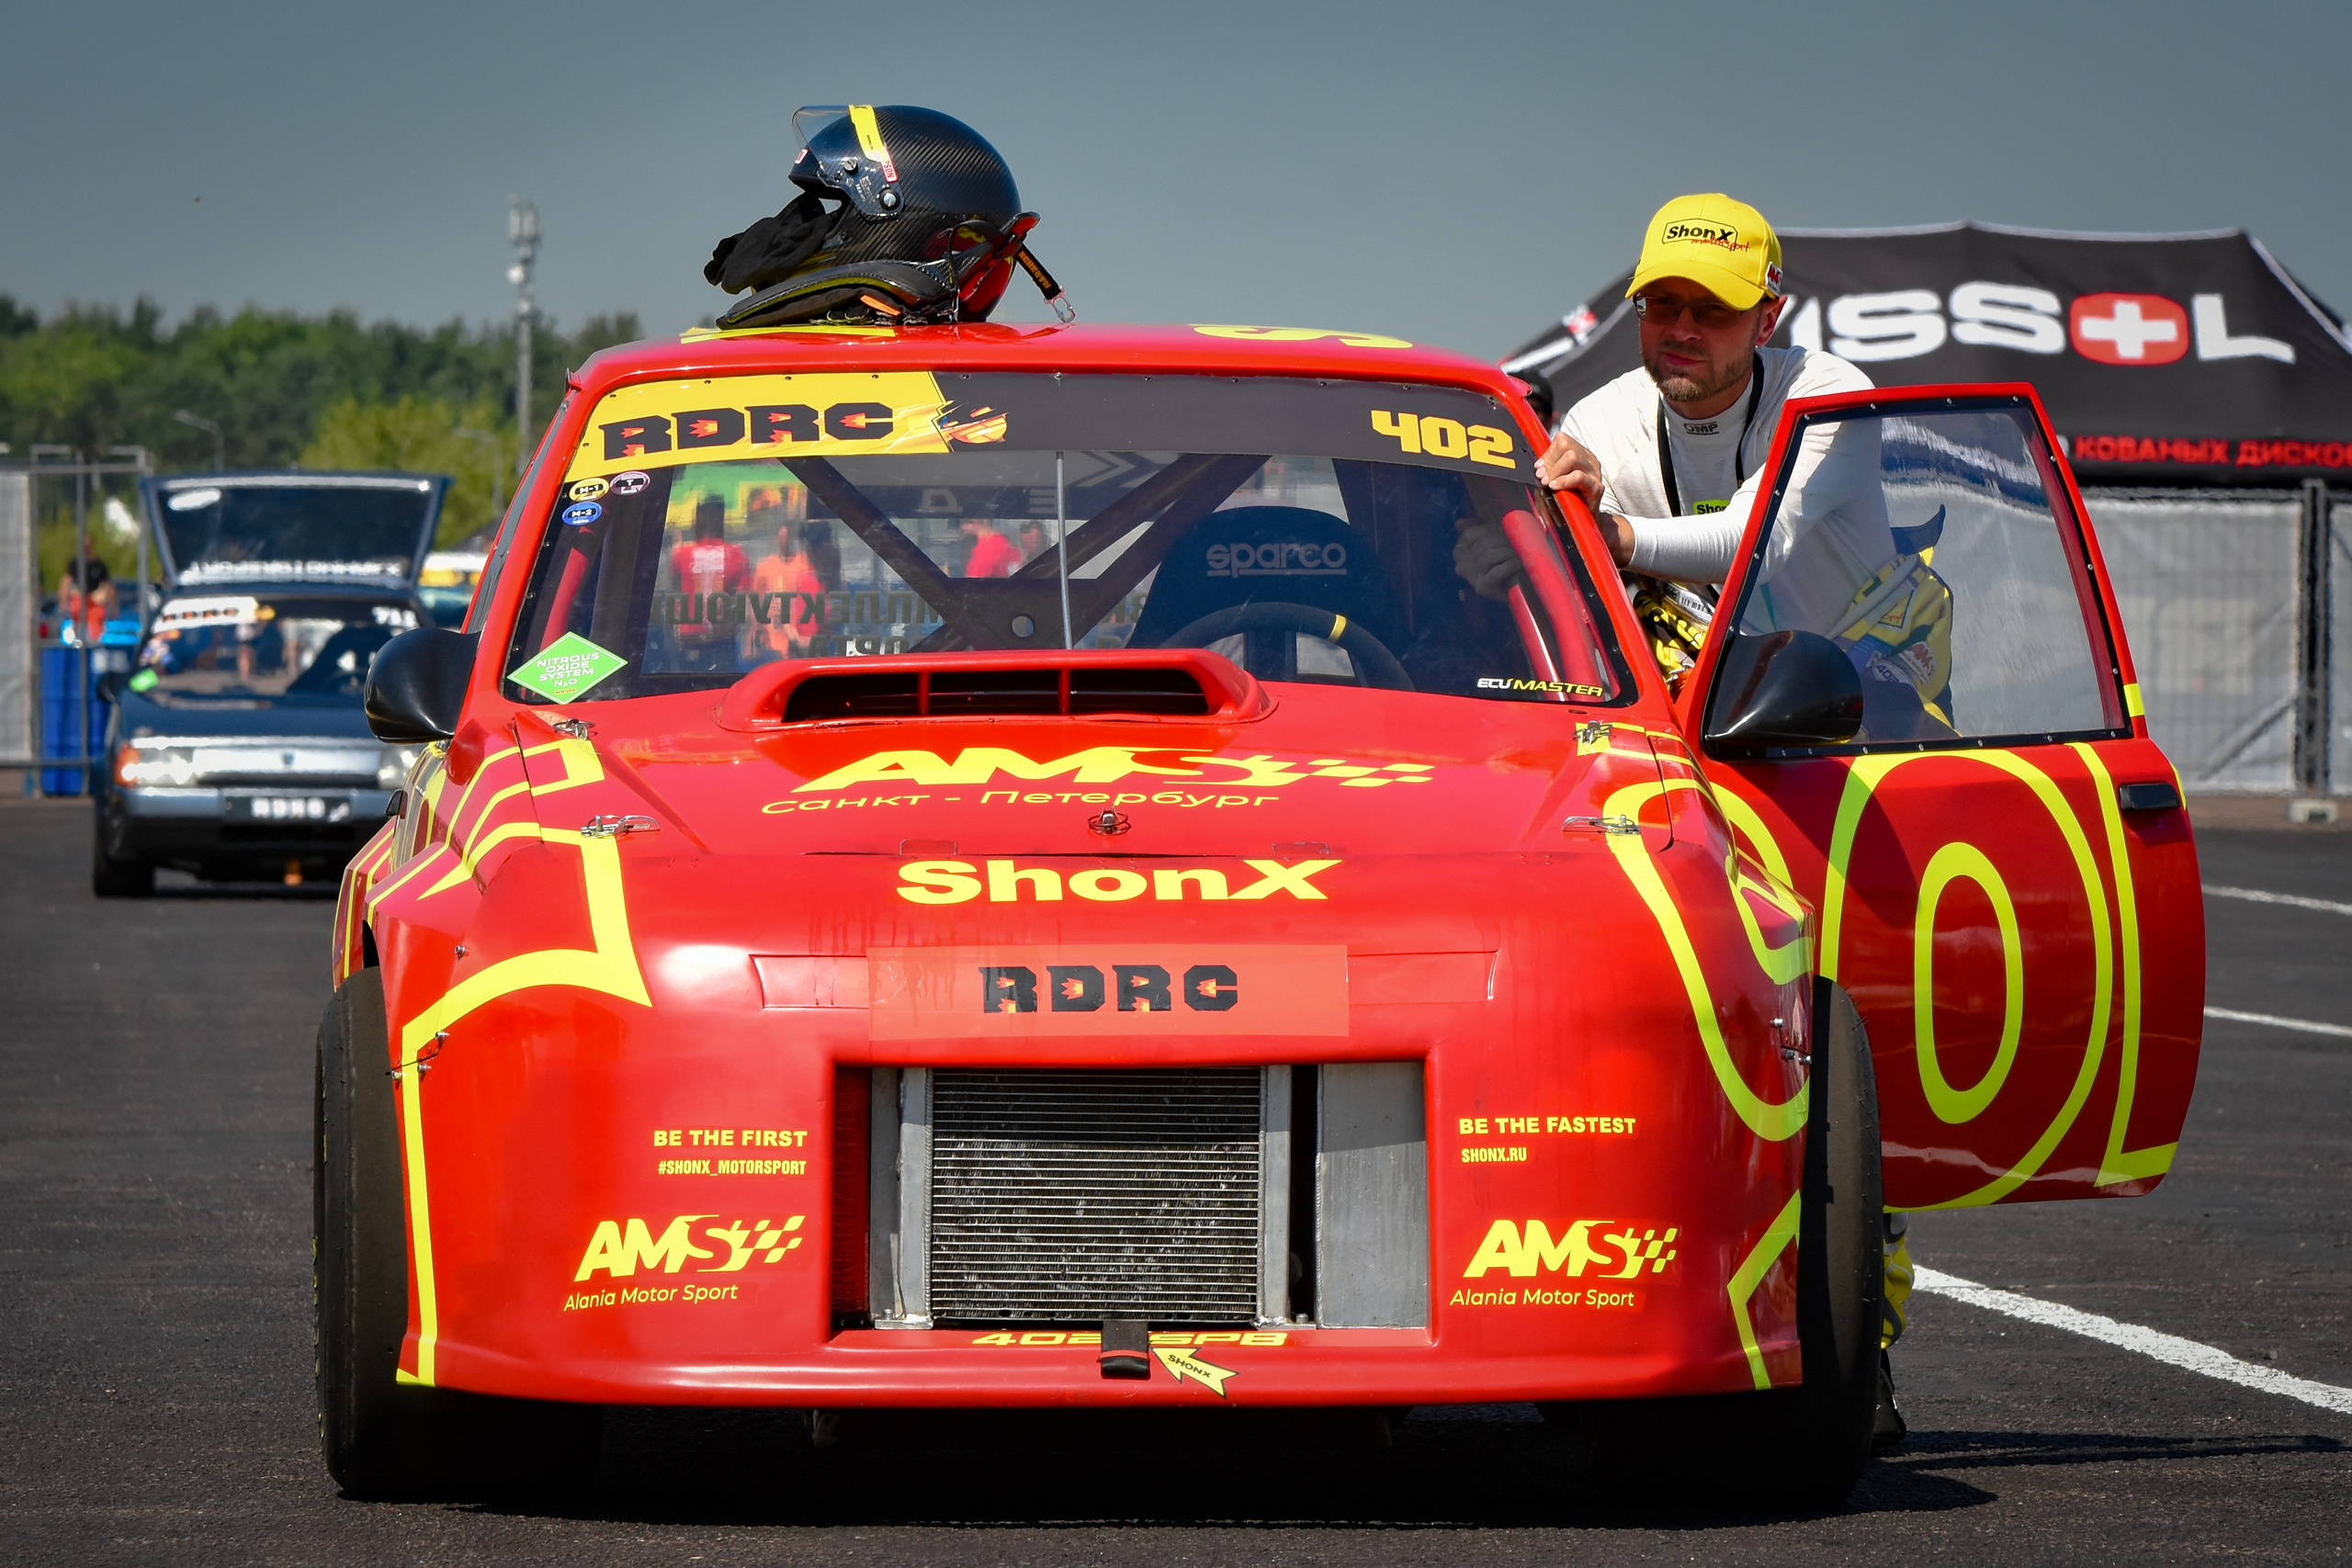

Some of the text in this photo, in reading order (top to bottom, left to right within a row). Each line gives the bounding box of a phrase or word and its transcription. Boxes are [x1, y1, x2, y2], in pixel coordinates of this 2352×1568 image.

[1666, 224, 1735, 241] ShonX
[1772, 281, 2294, 366] ISSOL
[598, 401, 893, 461] RDRC
[1684, 423, 1719, 434] OMP
[1371, 410, 1516, 469] 402
[579, 484, 599, 494] M-1
[571, 509, 592, 518] M-2
[1206, 543, 1347, 579] sparco
[537, 652, 600, 668] NITROUS
[545, 660, 590, 673] OXIDE
[539, 668, 594, 682] SYSTEM
[762, 793, 931, 814] Санкт
[979, 791, 1280, 809] Петербург
[897, 859, 1342, 905] ShonX
[978, 964, 1238, 1013] RDRC
[1459, 1116, 1636, 1134] BE THE FASTEST
[653, 1129, 808, 1147] BE THE FIRST
[1461, 1146, 1527, 1164] SHONX.RU
[658, 1159, 807, 1177] #SHONX_MOTORSPORT
[563, 1283, 738, 1312] Alania Motor Sport
[1450, 1288, 1634, 1309] Alania Motor Sport
[972, 1332, 1102, 1347] 402
[1168, 1353, 1212, 1379] SHONX
